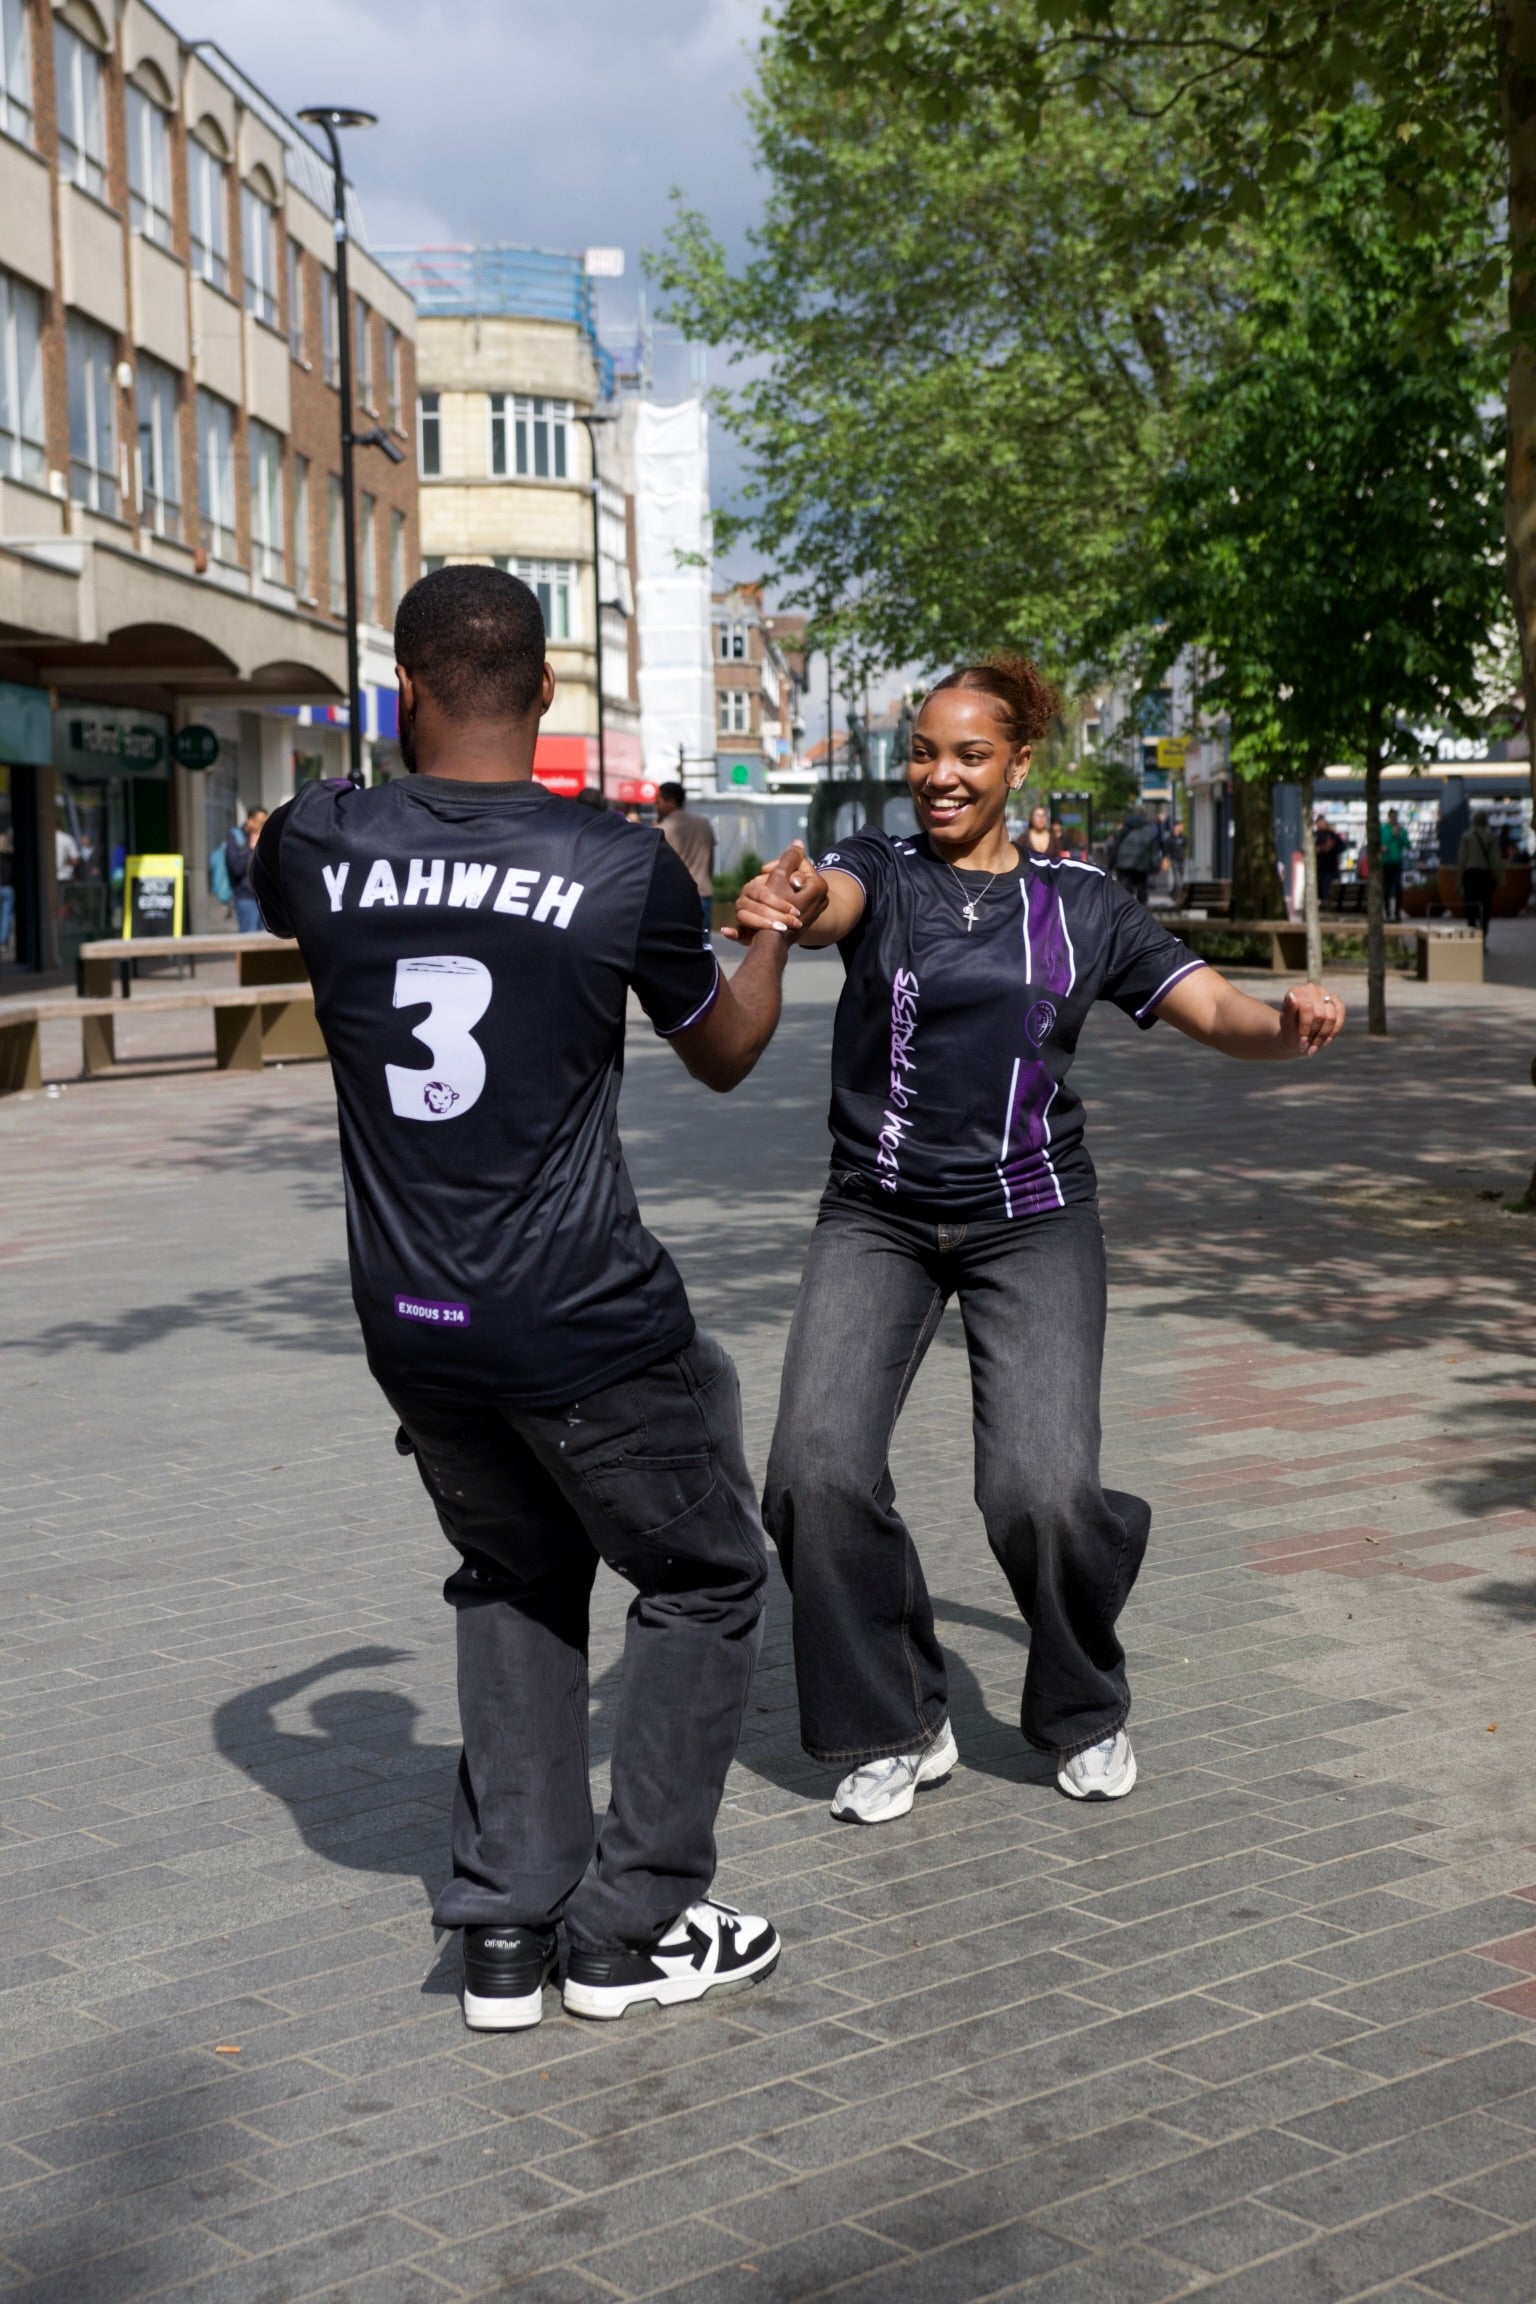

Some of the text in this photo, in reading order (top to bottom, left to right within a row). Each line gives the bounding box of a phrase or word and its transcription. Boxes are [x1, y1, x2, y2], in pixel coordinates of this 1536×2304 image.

[322, 858, 584, 930] YAHWEH
[385, 955, 493, 1121] 3
[890, 967, 920, 1072] PRIESTS
[889, 1069, 918, 1109] OF
[398, 1301, 465, 1322] EXODUS 3:14
